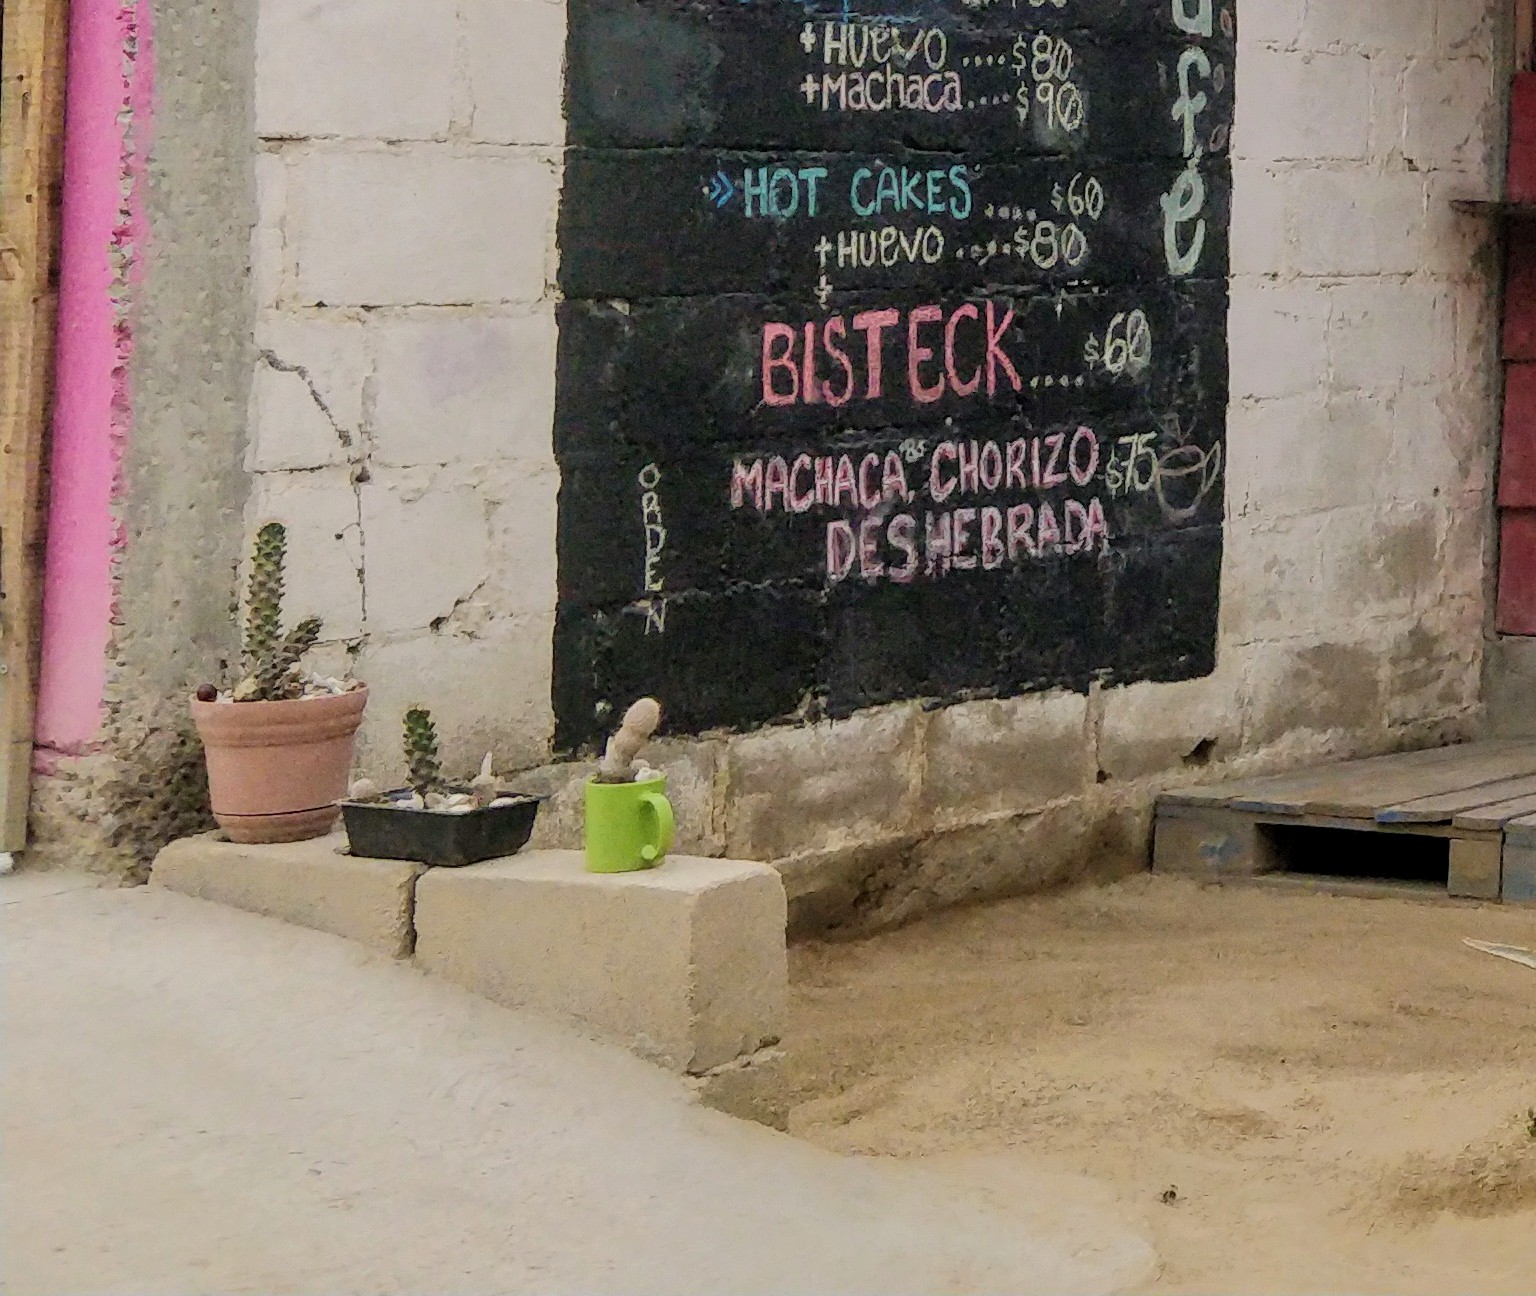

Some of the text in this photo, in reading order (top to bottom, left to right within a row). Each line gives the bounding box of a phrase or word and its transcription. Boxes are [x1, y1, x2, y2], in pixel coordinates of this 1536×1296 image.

[743, 165, 829, 220] HOT
[850, 163, 972, 220] CAKES
[760, 299, 1023, 408] BISTECK
[928, 425, 1099, 503] CHORIZO
[826, 496, 1112, 584] DESHEBRADA
